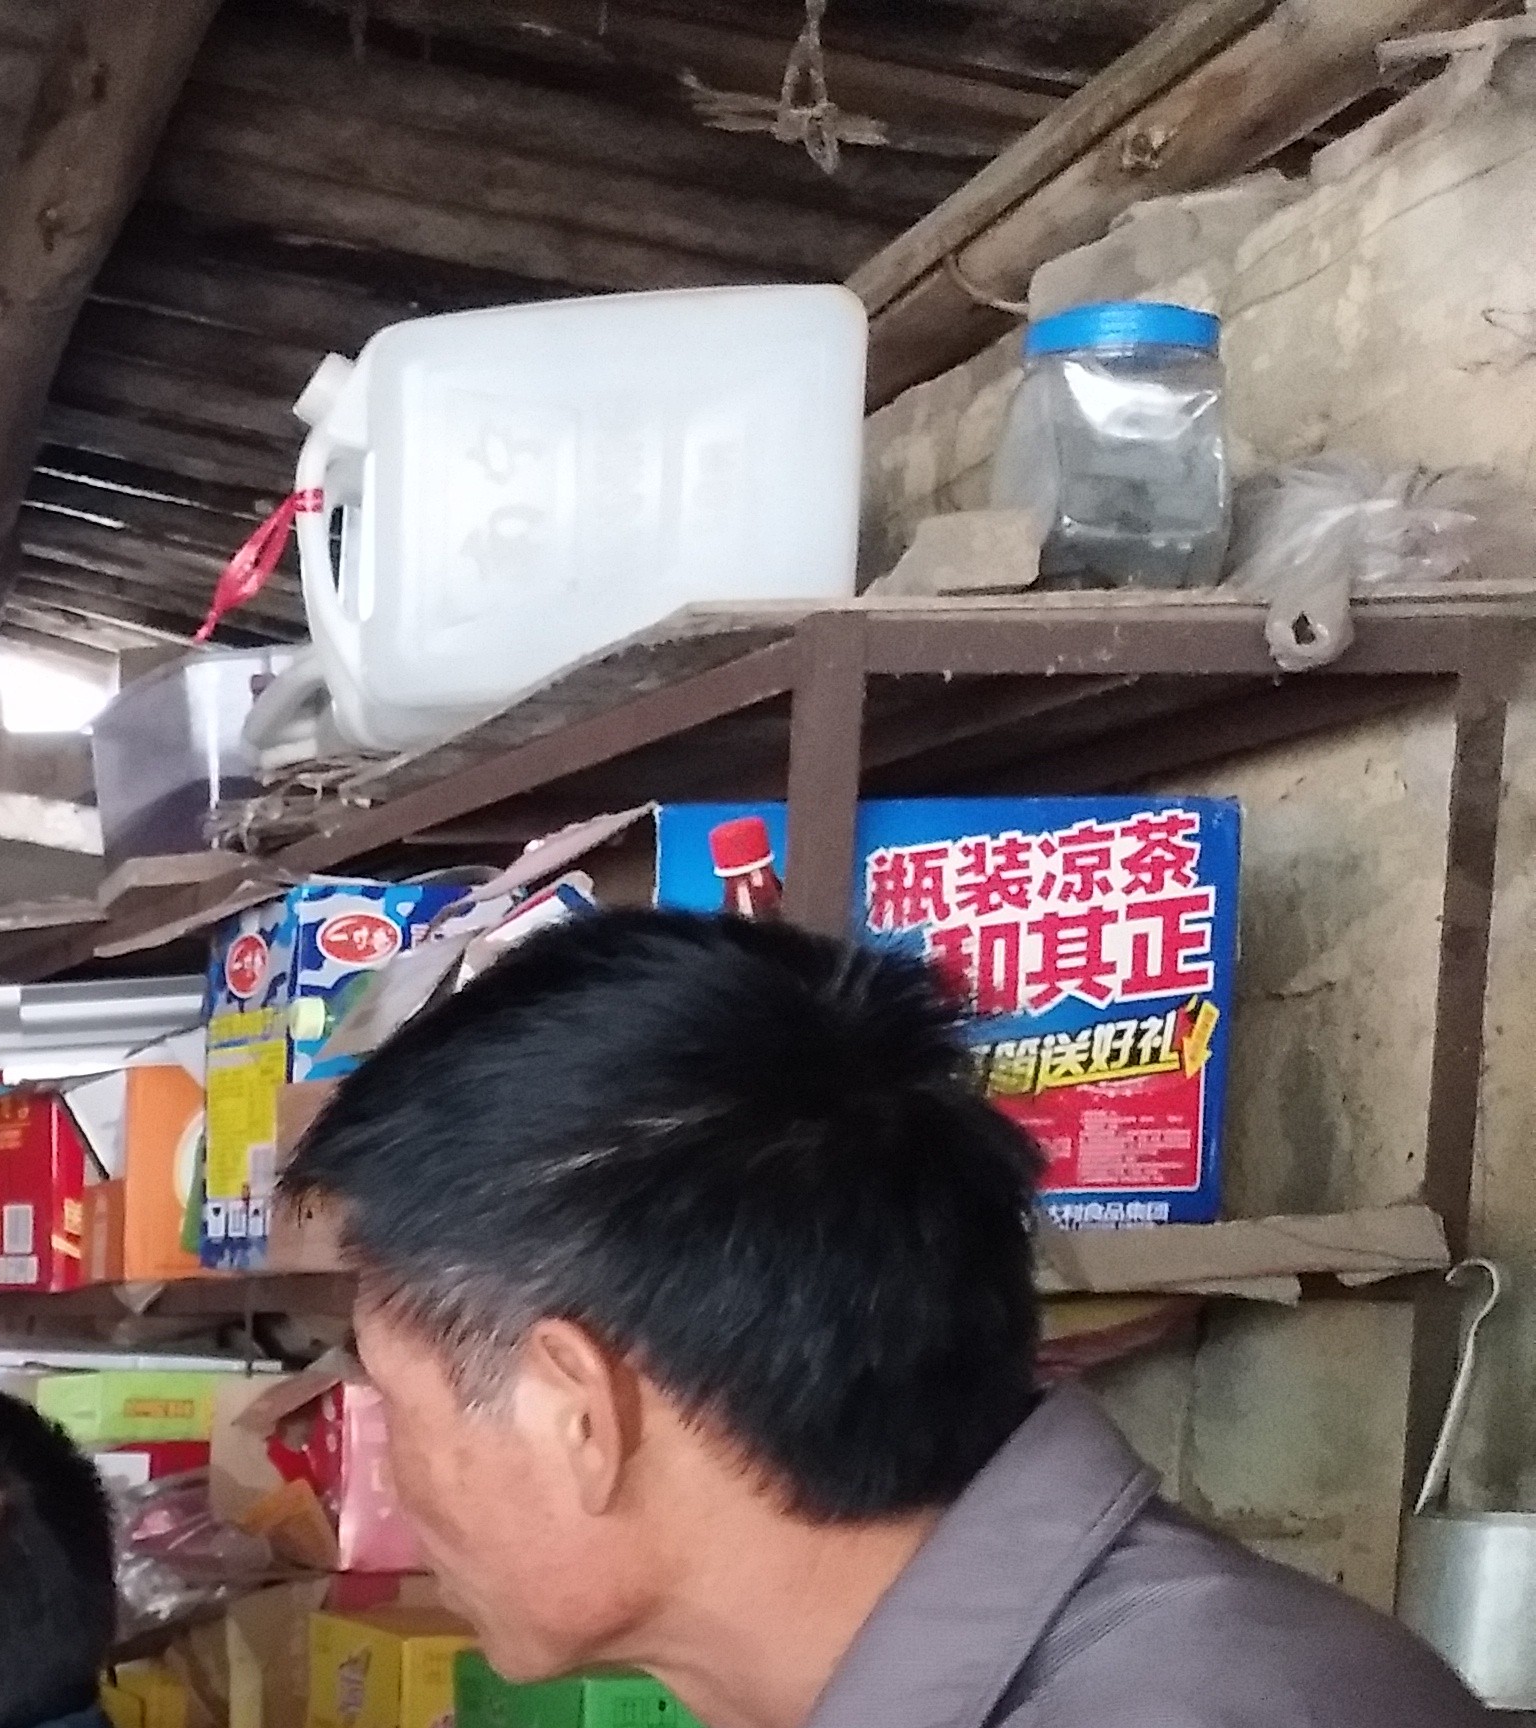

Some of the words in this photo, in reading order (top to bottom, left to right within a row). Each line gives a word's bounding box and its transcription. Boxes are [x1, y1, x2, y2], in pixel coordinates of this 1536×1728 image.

[868, 813, 1199, 928] 瓶装凉茶
[928, 893, 1212, 1014] 和其正
